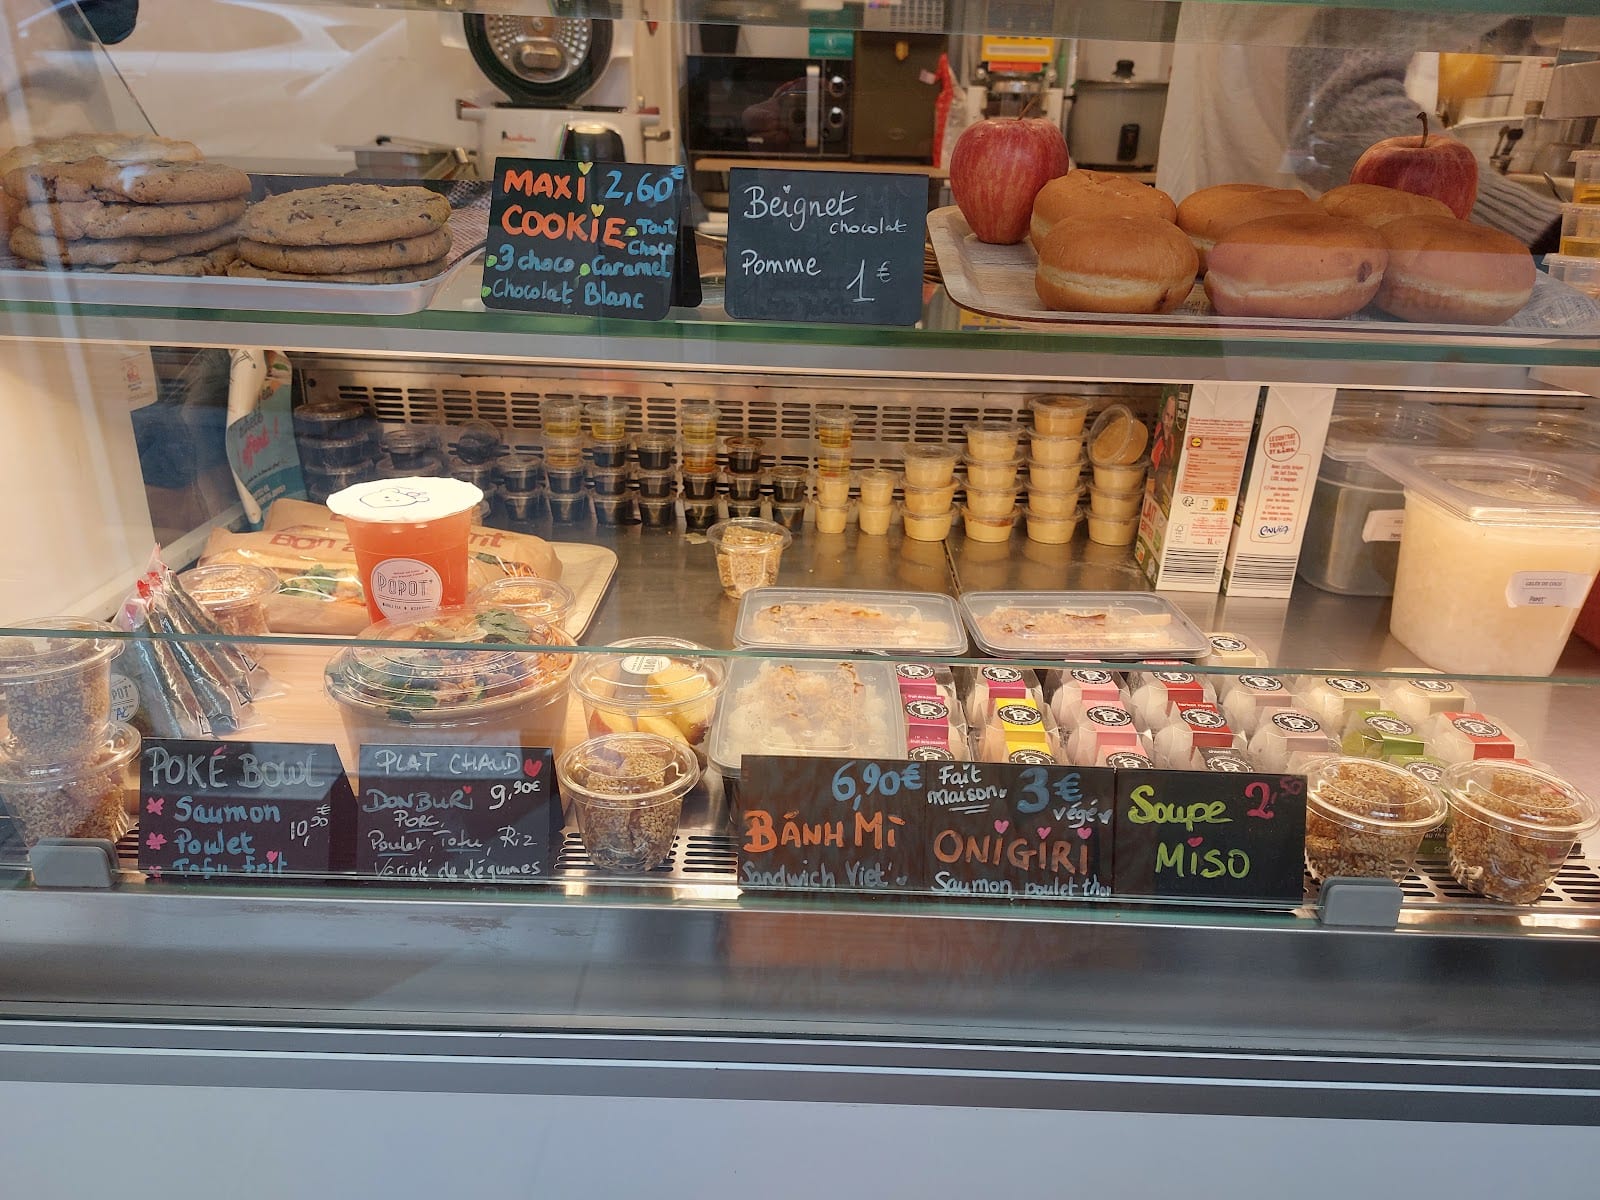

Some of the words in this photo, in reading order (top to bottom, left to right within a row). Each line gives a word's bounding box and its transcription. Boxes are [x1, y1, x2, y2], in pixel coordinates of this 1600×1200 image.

[743, 184, 858, 232] Beignet
[636, 218, 677, 235] Tout
[830, 217, 907, 234] chocolat
[495, 244, 514, 271] 3
[518, 250, 575, 273] choco
[591, 254, 672, 278] Caramel
[741, 250, 821, 276] Pomme
[493, 279, 574, 305] Chocolat
[584, 281, 645, 310] Blanc
[146, 746, 229, 789] POKÉ
[375, 750, 438, 775] PLAT
[938, 763, 982, 785] Fait
[832, 761, 923, 811] 6,90€
[927, 784, 998, 806] maison
[174, 795, 281, 824] Saumon
[1053, 799, 1100, 829] végé
[1128, 784, 1233, 832] Soupe
[174, 828, 256, 855] Poulet
[498, 825, 537, 848] Riz
[438, 861, 459, 880] de
[740, 860, 836, 888] Sandwich
[1025, 876, 1079, 897] poulet
